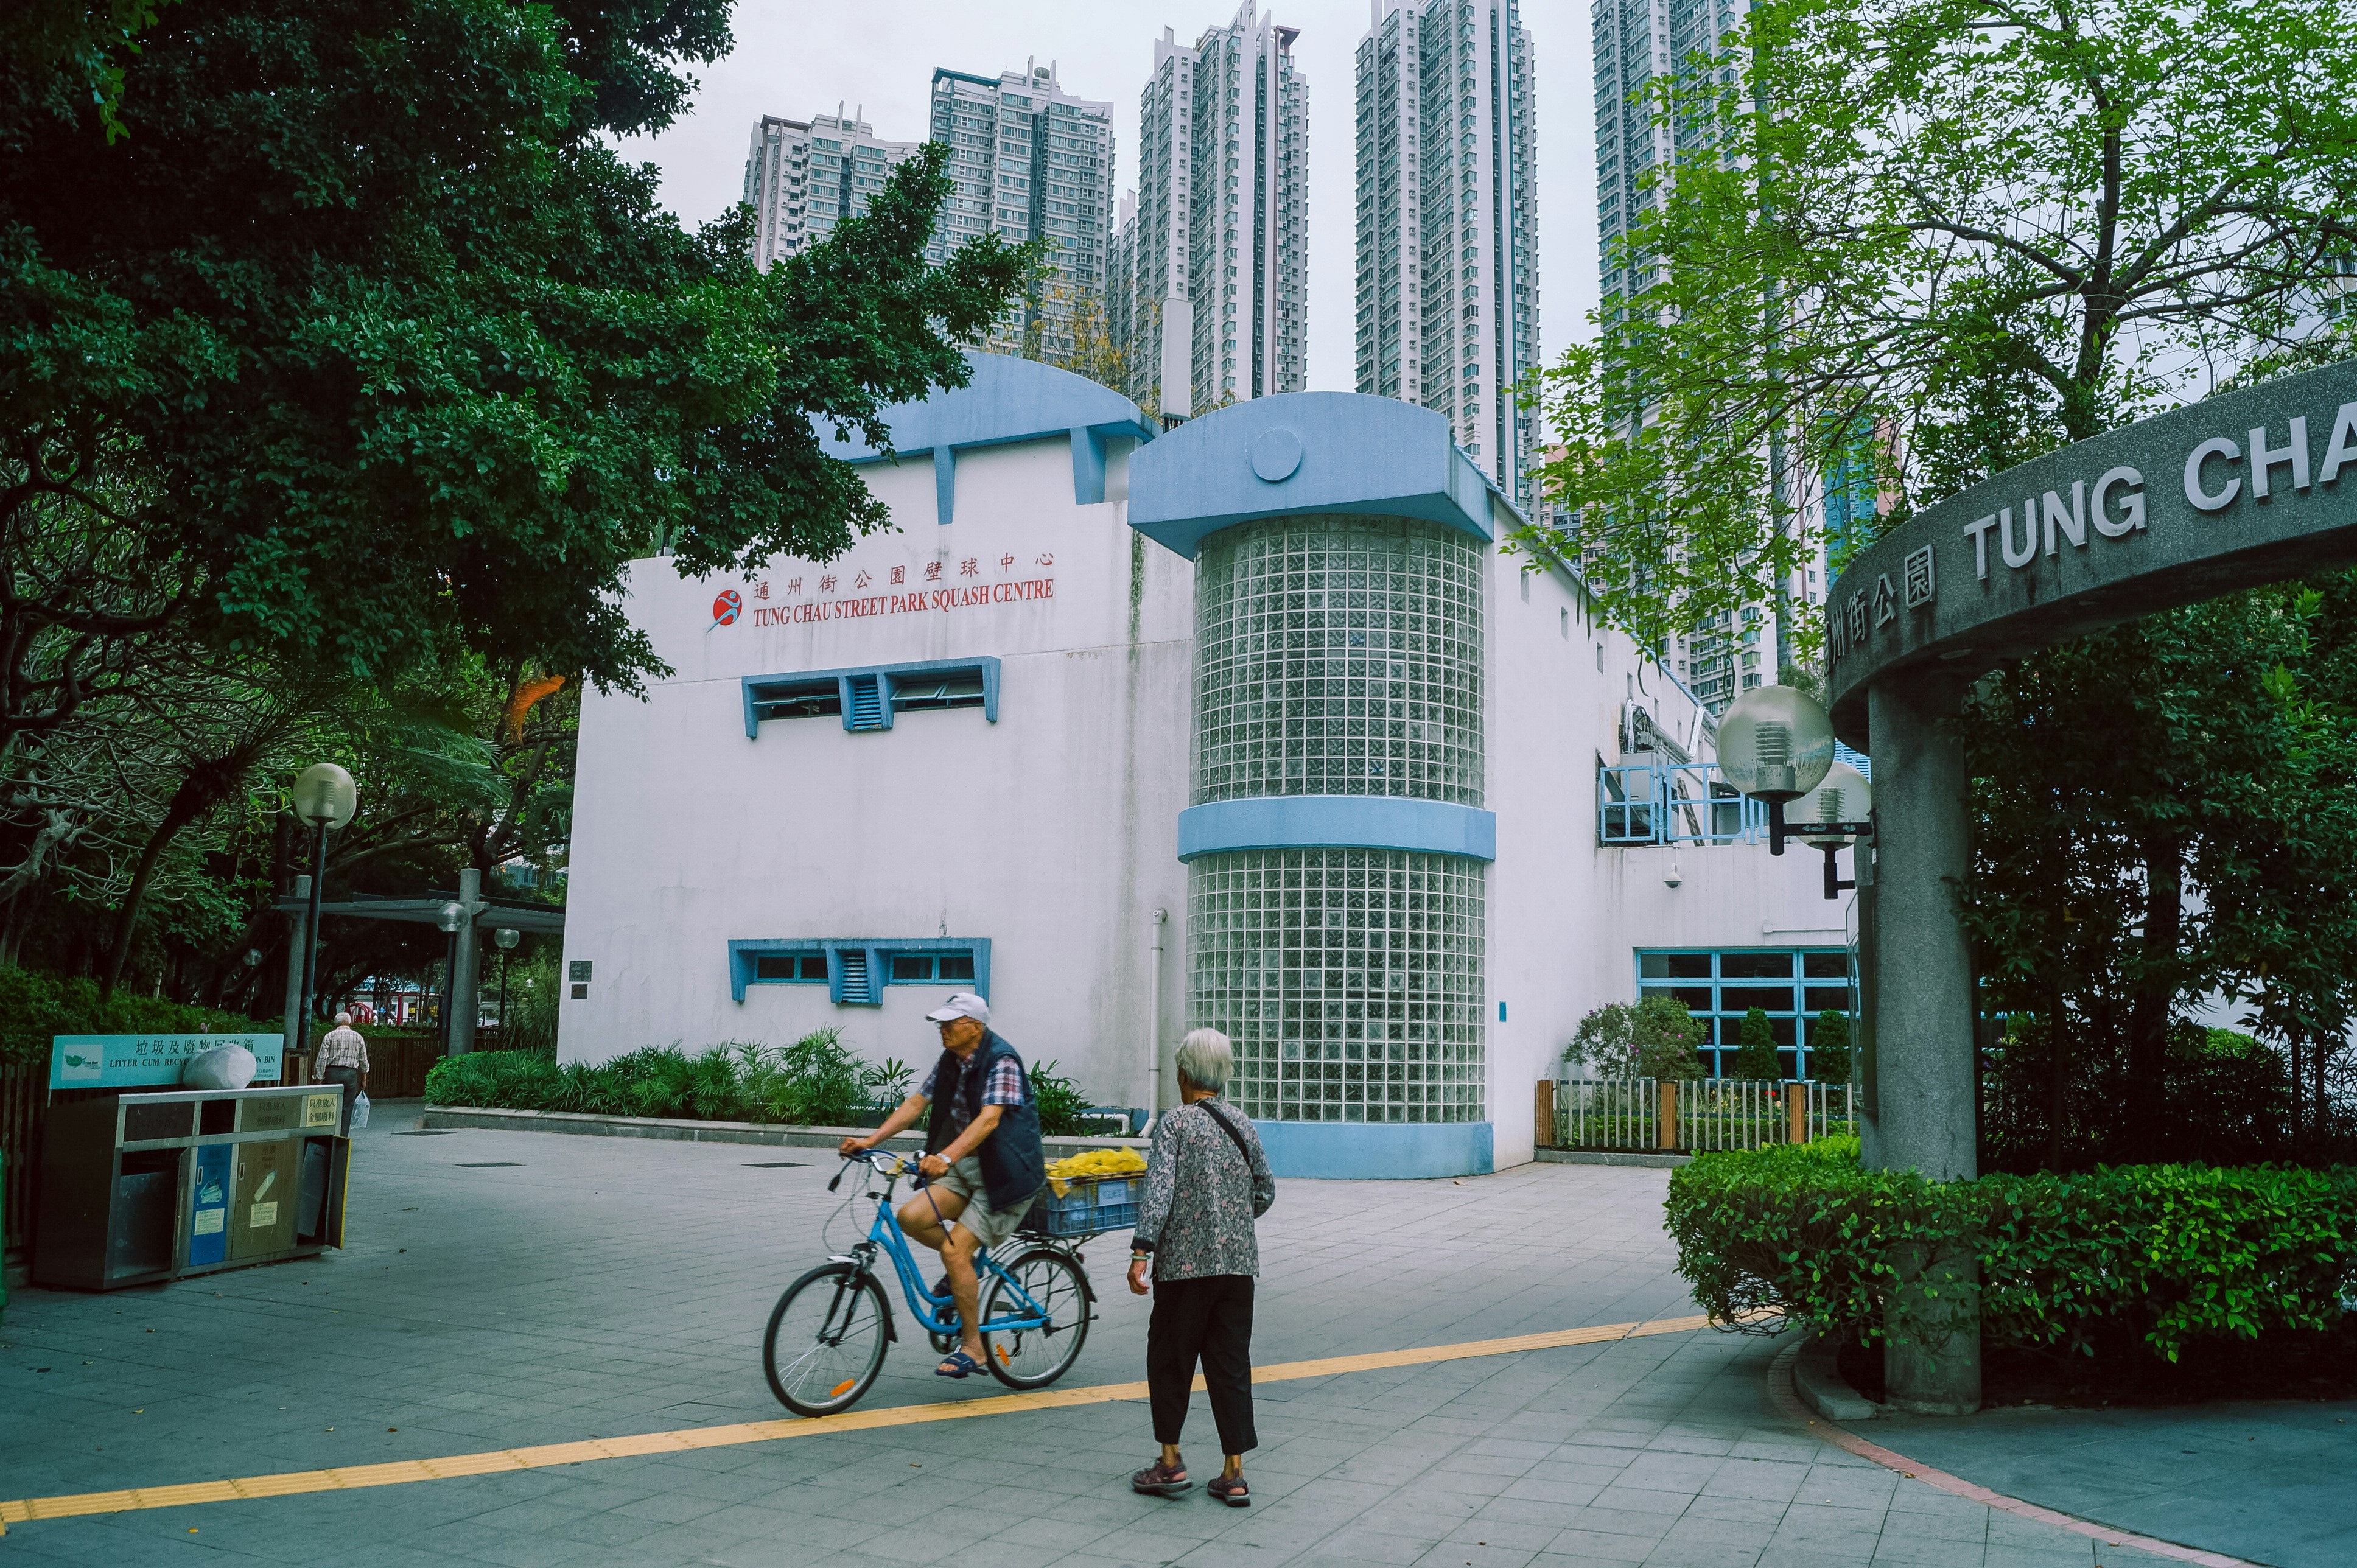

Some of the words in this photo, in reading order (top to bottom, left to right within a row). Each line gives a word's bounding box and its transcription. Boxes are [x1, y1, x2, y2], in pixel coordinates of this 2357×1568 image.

[1963, 466, 2148, 581] TUNG
[2183, 401, 2357, 511] CHA
[754, 552, 1054, 600] 通州街公園壁球中心
[754, 606, 791, 627] TUNG
[793, 601, 832, 623] CHAU
[835, 596, 888, 619] STREET
[890, 592, 929, 614] PARK
[931, 585, 990, 612] SQUASH
[993, 578, 1054, 603] CENTRE
[1824, 543, 1936, 676] 州街公園
[110, 1059, 138, 1068] LITTER
